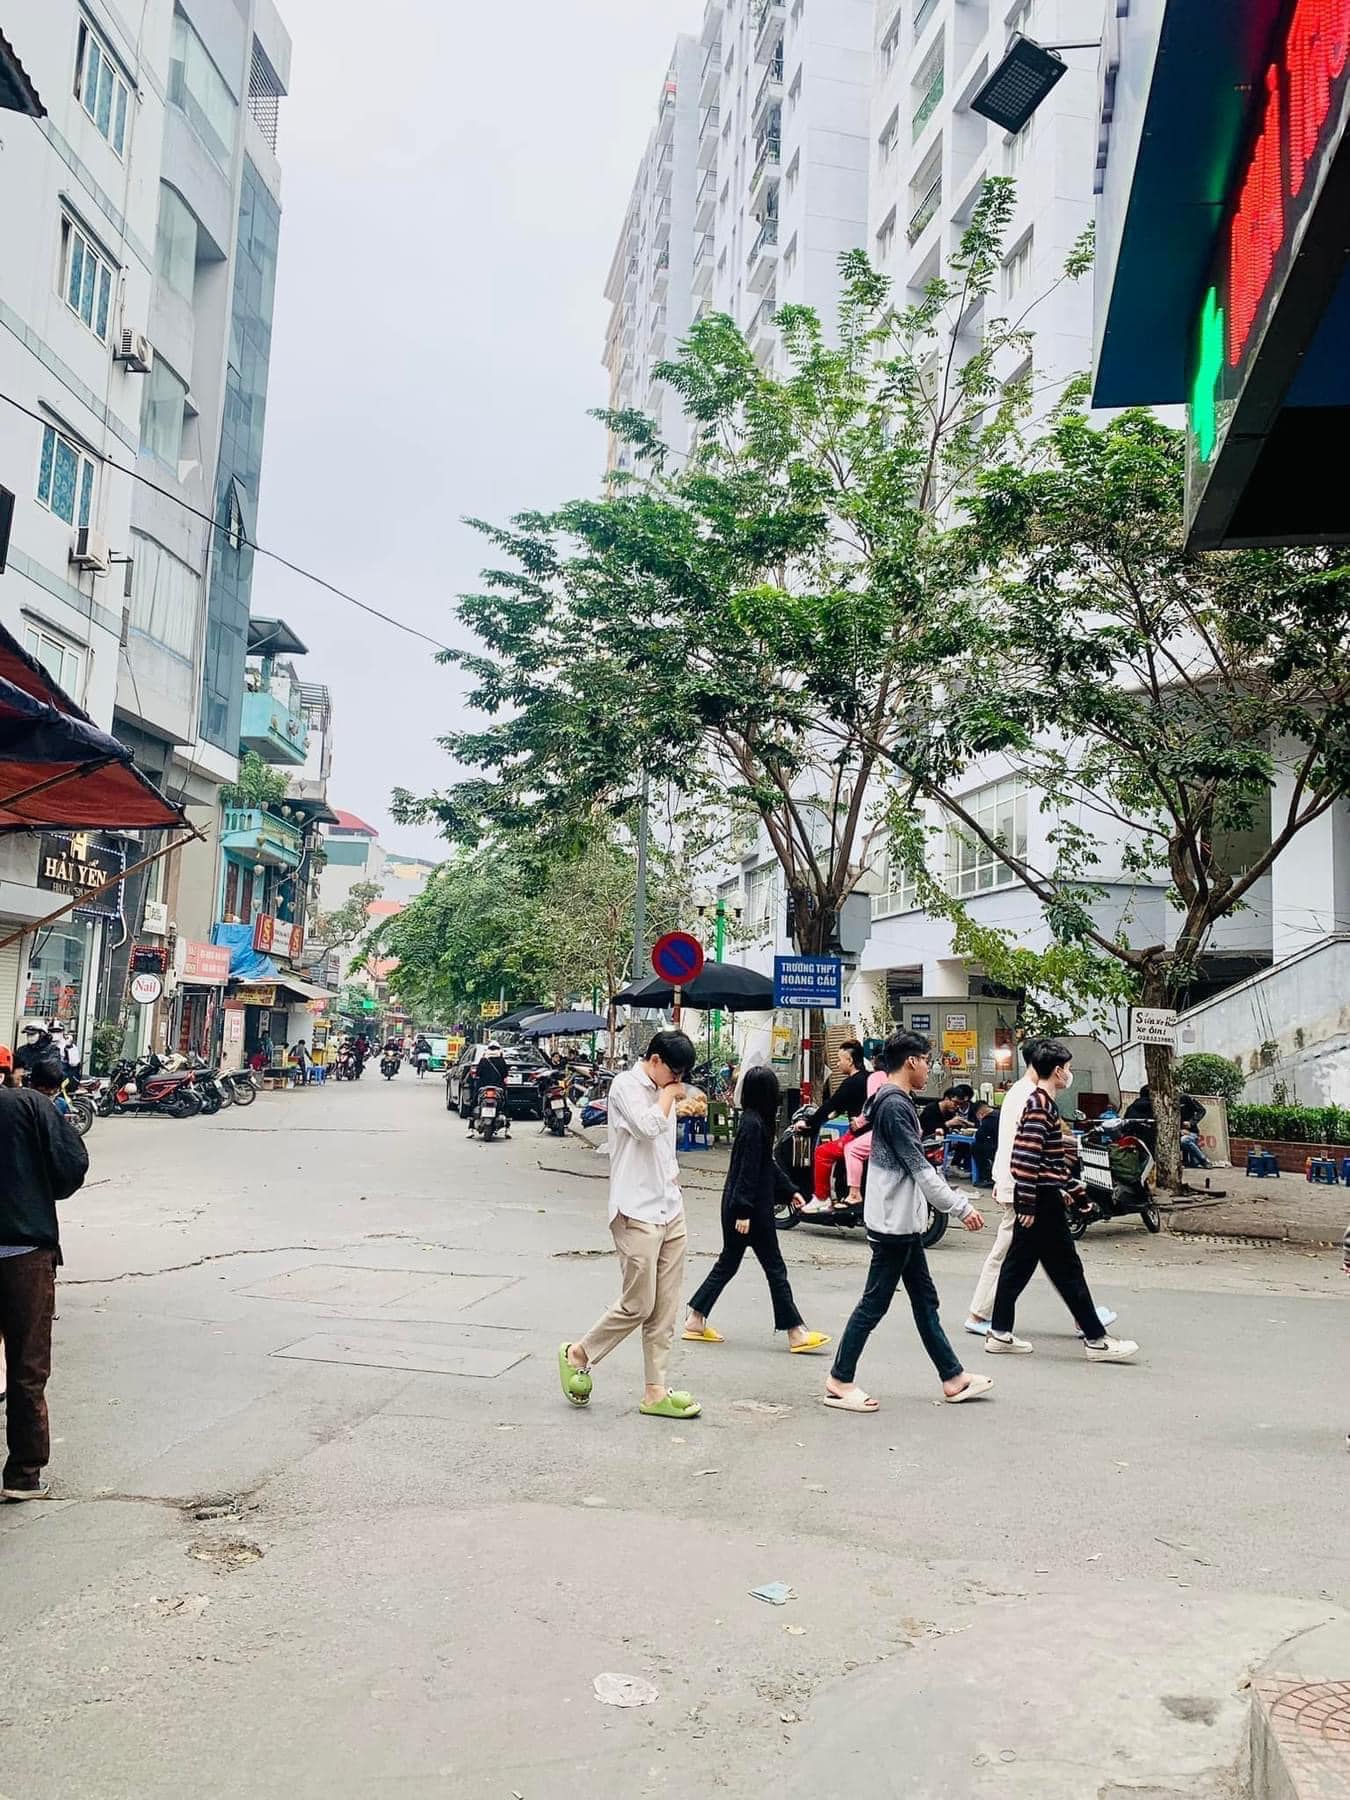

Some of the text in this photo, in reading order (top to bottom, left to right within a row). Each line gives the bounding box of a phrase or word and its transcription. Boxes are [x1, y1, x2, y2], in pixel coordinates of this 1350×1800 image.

[78, 859, 108, 888] YẾN
[816, 963, 837, 975] THPT
[135, 979, 157, 993] Nail
